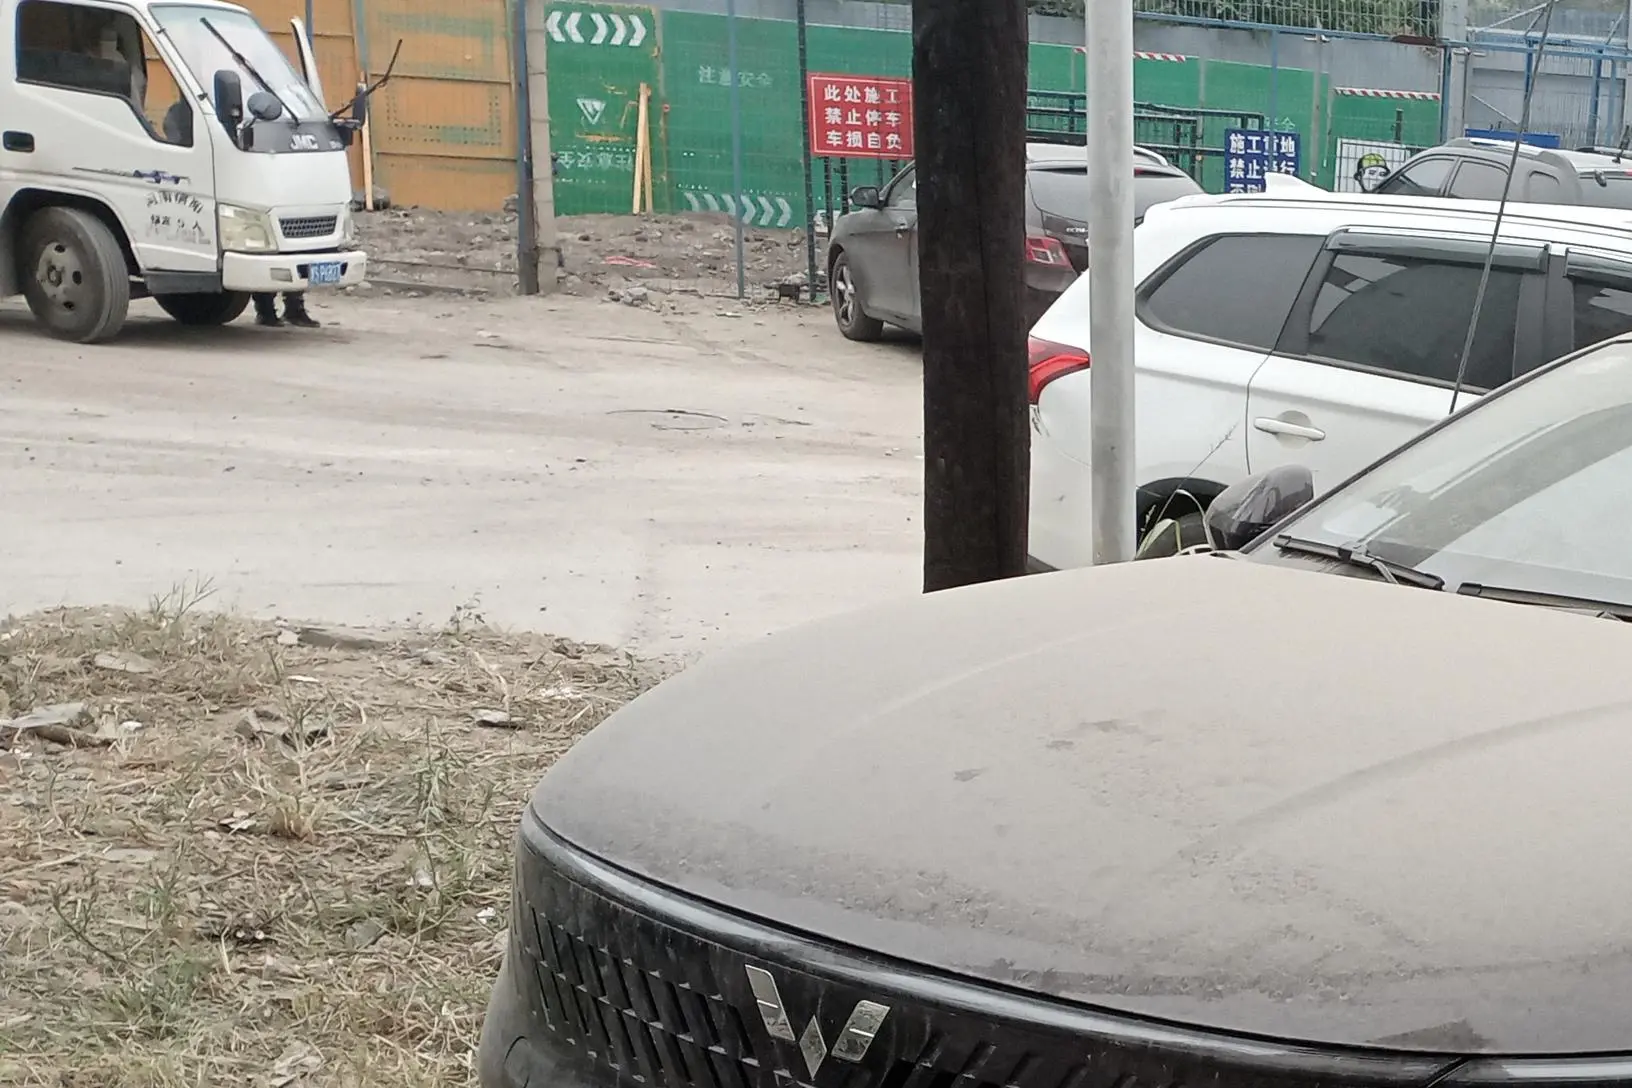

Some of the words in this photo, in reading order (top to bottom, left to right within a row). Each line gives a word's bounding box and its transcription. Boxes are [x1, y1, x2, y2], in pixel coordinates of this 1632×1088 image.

[824, 84, 900, 104] 此处施工
[824, 107, 901, 127] 禁止停车
[826, 130, 902, 149] 车损自负
[1229, 133, 1296, 157] 施工重地
